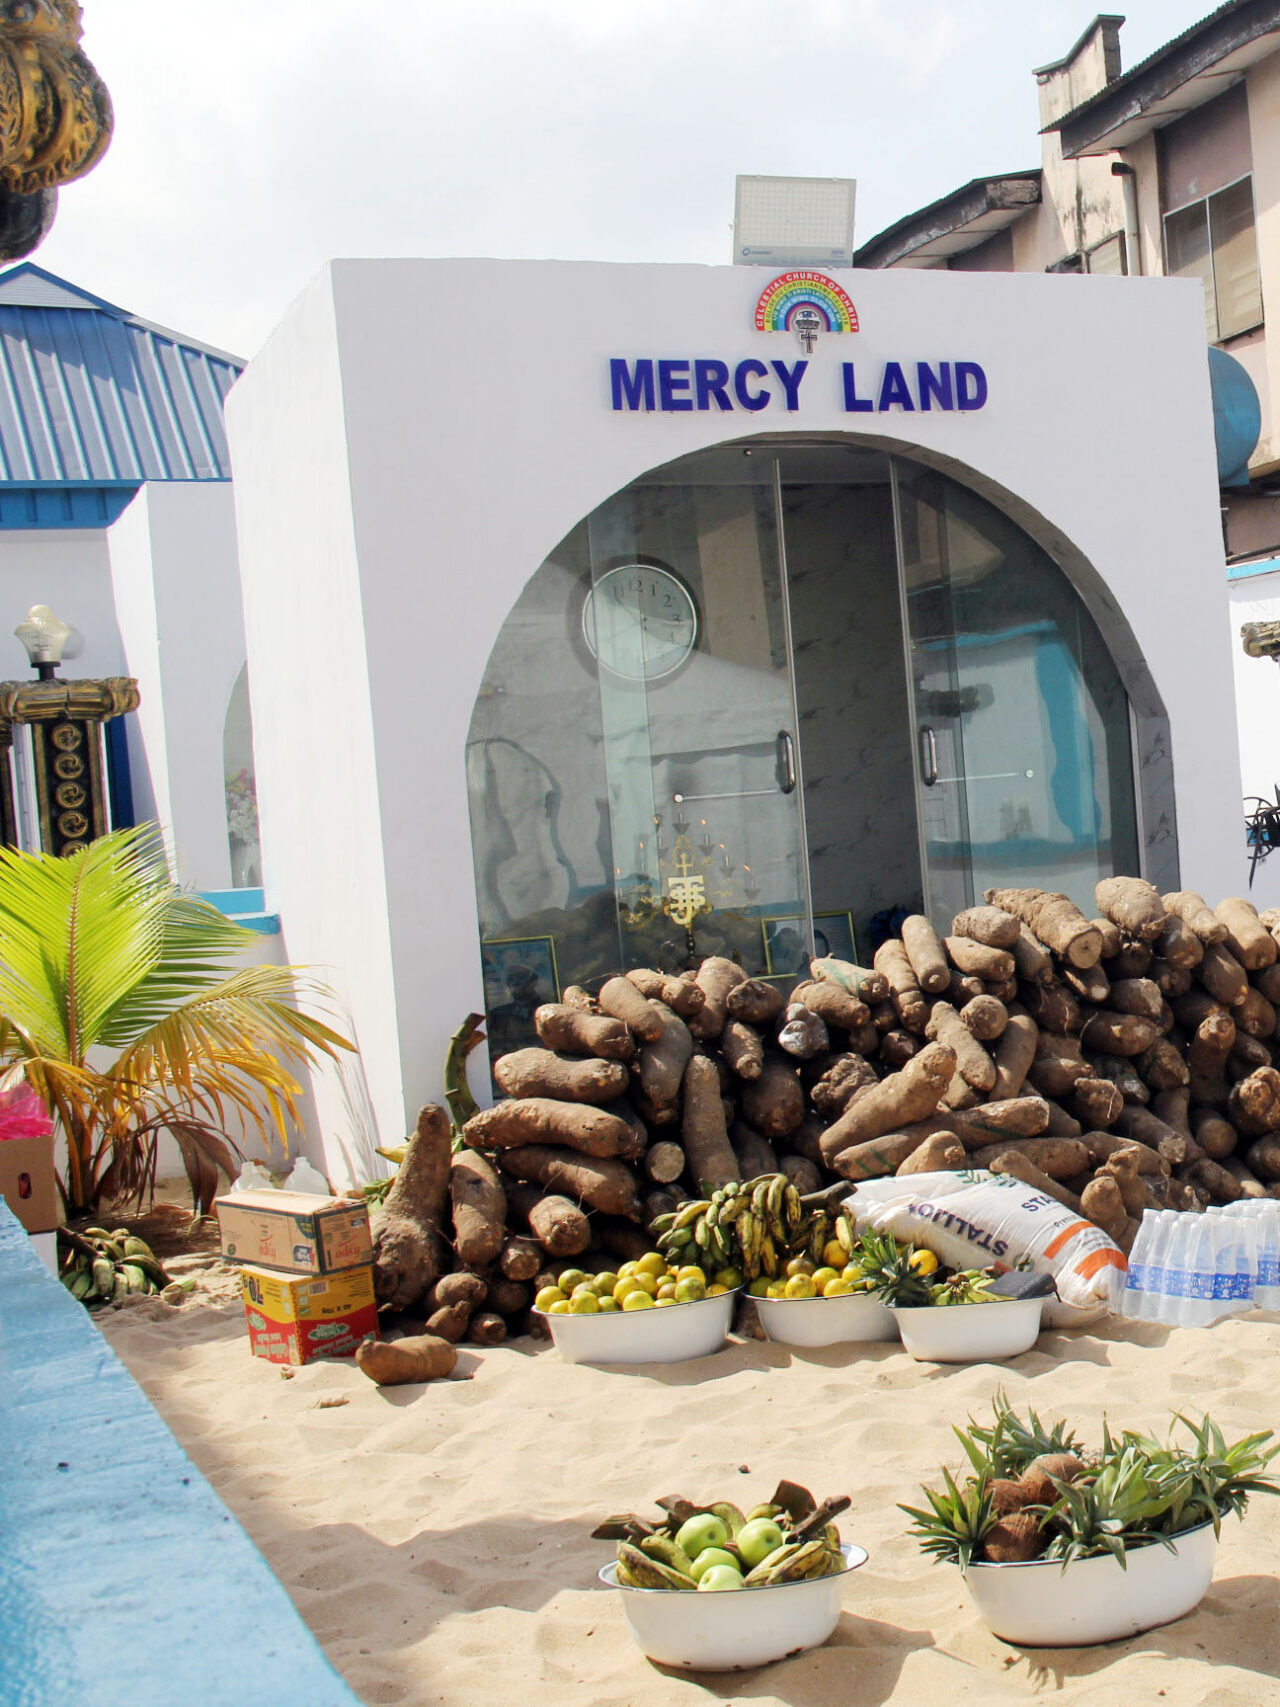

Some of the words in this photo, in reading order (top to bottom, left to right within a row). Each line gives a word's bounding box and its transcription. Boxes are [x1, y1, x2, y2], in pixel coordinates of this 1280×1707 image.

[757, 279, 785, 326] CELESTIAL
[786, 273, 827, 284] CHURCH
[828, 282, 840, 292] OF
[840, 294, 858, 330] CHRIST
[609, 358, 809, 412] MERCY
[842, 361, 989, 413] LAND
